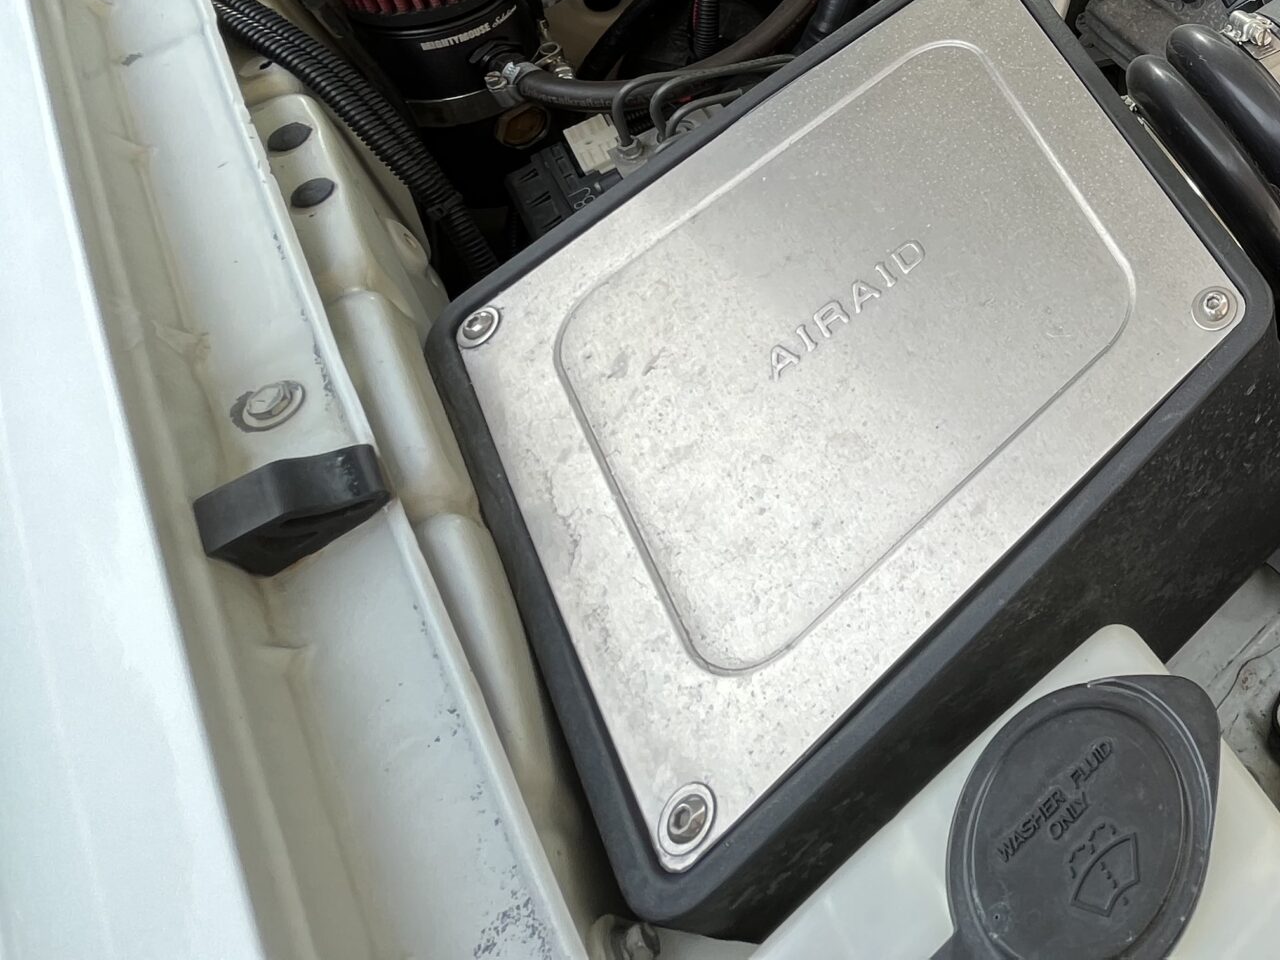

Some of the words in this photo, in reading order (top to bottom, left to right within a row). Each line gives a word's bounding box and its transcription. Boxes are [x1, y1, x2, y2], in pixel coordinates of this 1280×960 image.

[769, 240, 926, 382] AIRAID
[996, 787, 1067, 863] WASHER
[1069, 739, 1114, 791] FLUID
[1048, 791, 1089, 842] ONLY
